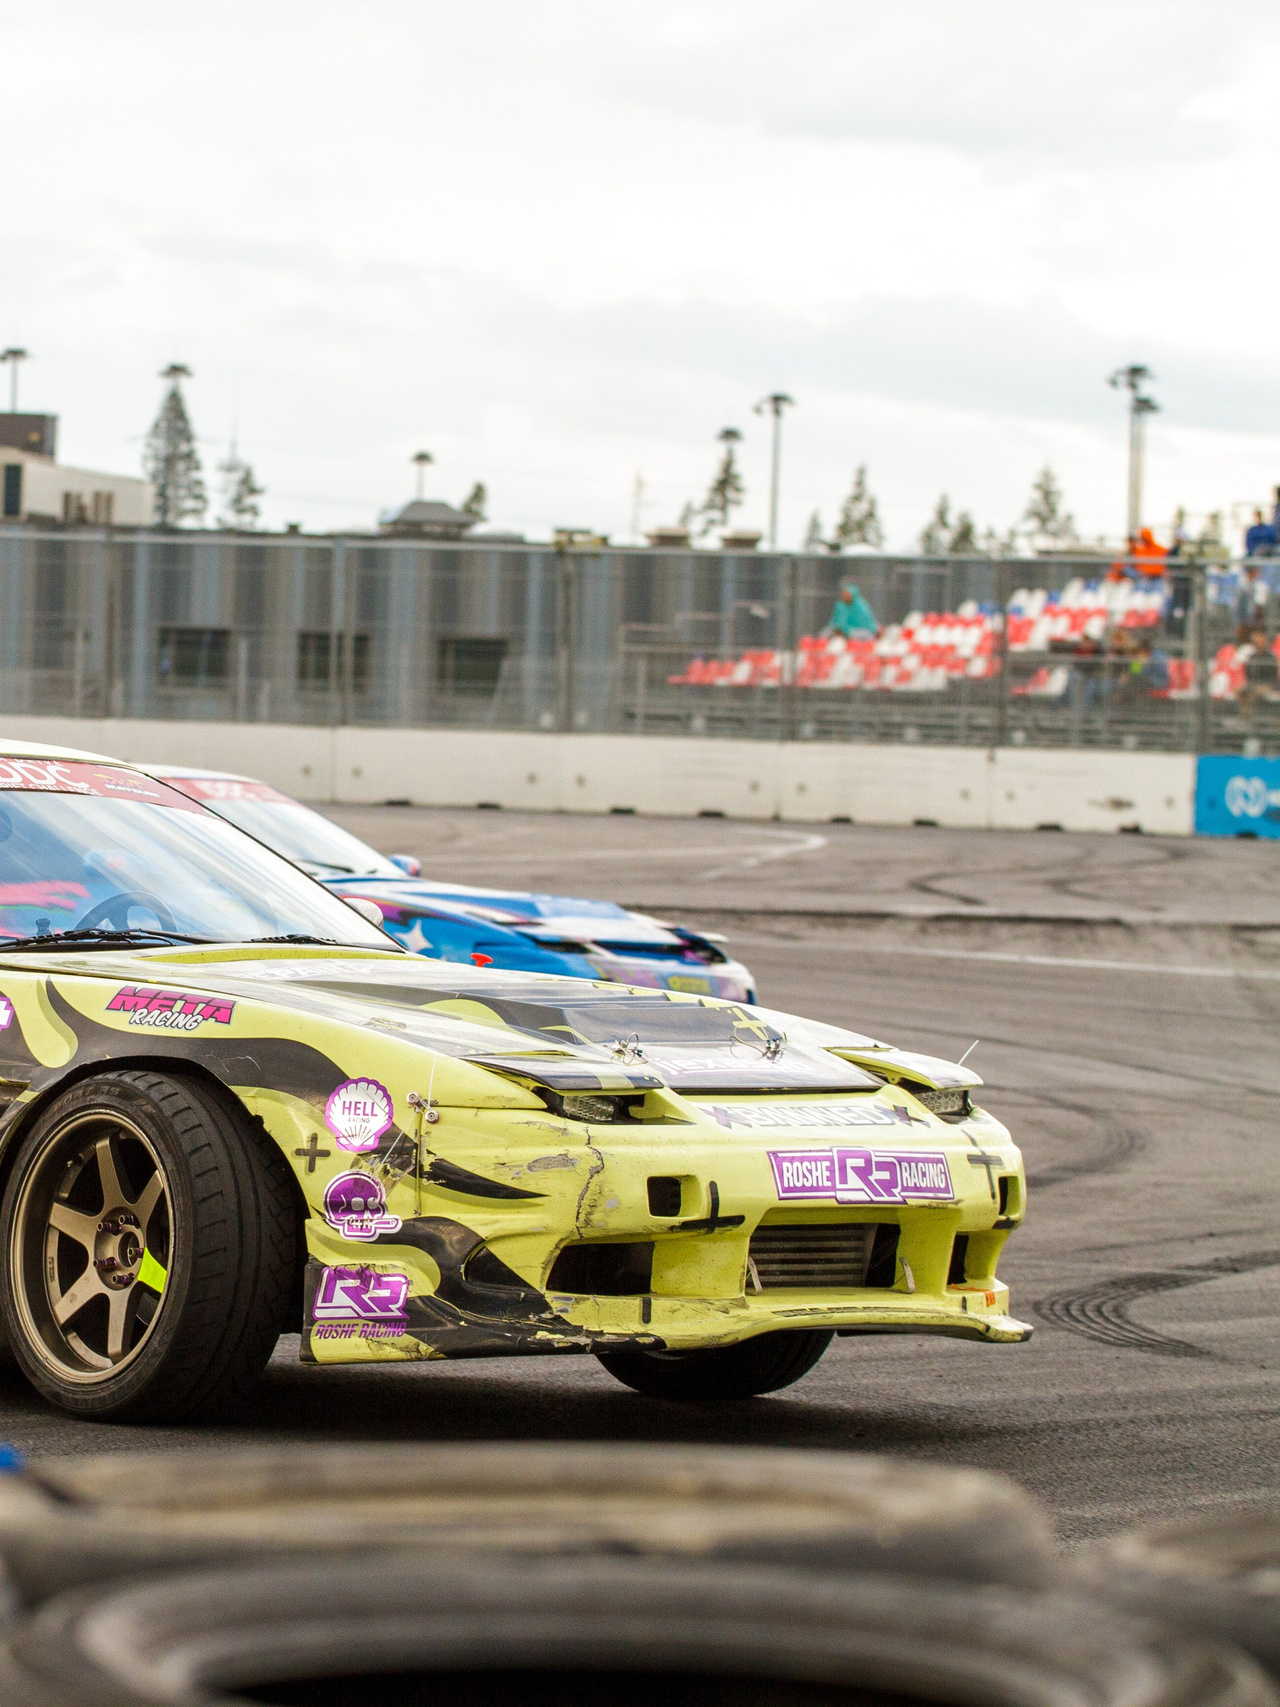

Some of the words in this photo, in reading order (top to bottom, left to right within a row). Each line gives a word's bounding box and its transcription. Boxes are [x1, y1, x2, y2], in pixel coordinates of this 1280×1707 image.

[105, 985, 237, 1025] META
[129, 1008, 205, 1031] RACING
[342, 1101, 378, 1117] HELL
[783, 1160, 832, 1188] ROSHE
[902, 1161, 947, 1188] RACING
[358, 1321, 407, 1339] RACING
